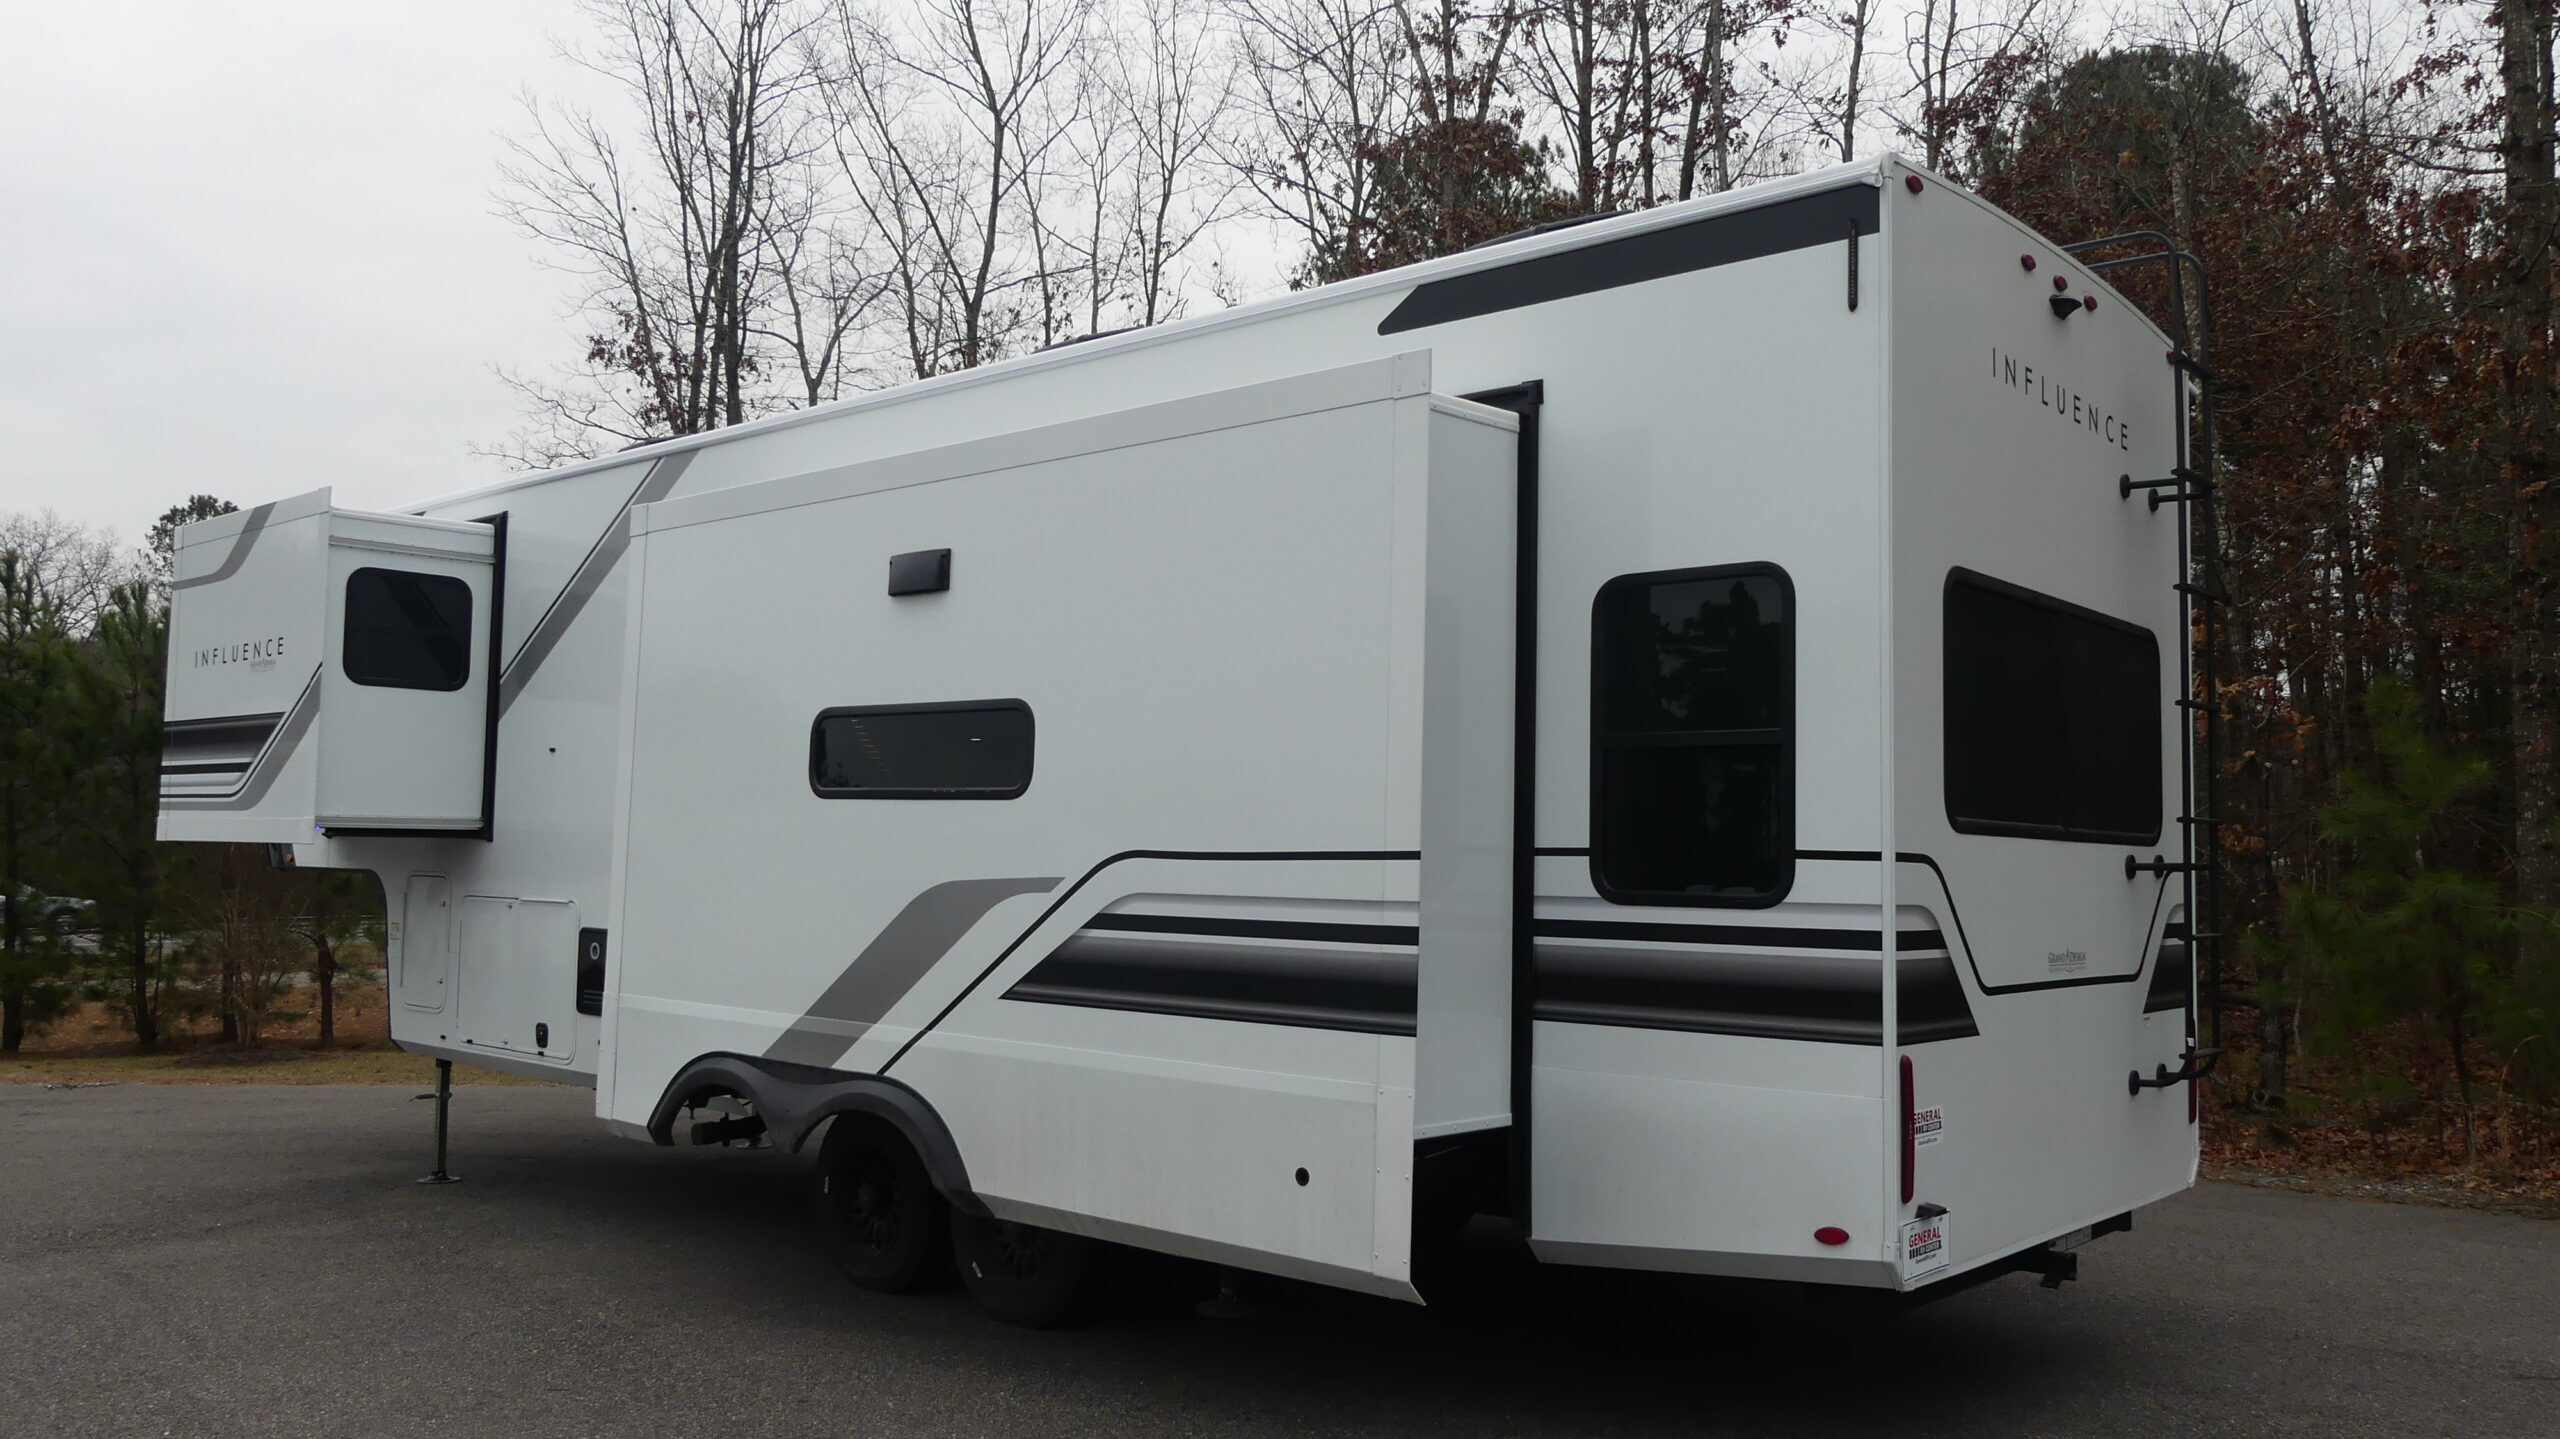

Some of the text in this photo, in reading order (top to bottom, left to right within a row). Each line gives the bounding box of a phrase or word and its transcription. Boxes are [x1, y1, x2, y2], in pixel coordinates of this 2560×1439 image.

[1993, 347, 2128, 451] INFLUENCE
[195, 637, 284, 669] INFLUENCE
[1909, 1226, 1941, 1248] GENERAL
